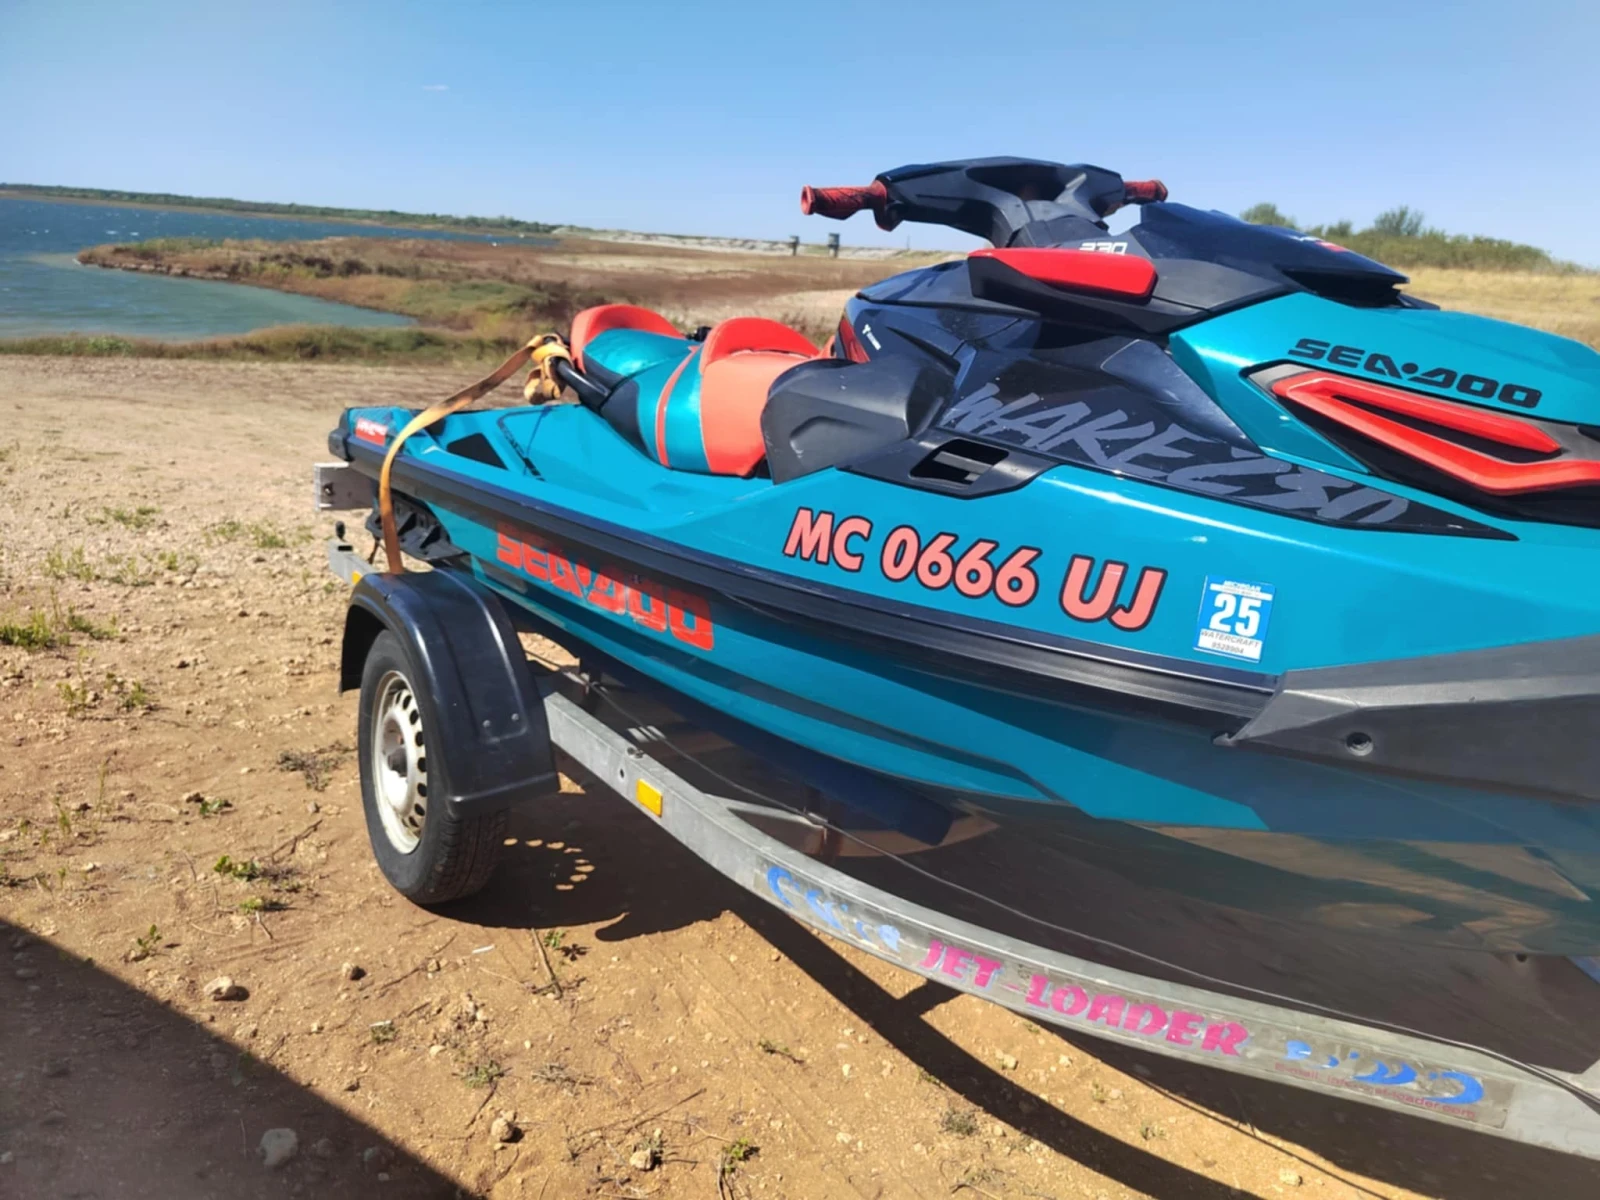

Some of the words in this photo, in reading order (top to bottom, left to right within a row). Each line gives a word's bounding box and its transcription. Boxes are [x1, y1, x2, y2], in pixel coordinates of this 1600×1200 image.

[783, 507, 873, 572] MC
[880, 525, 1042, 607] 0666
[1059, 555, 1168, 632] UJ
[1209, 592, 1262, 637] 25
[1200, 630, 1259, 648] WATERCRAFT
